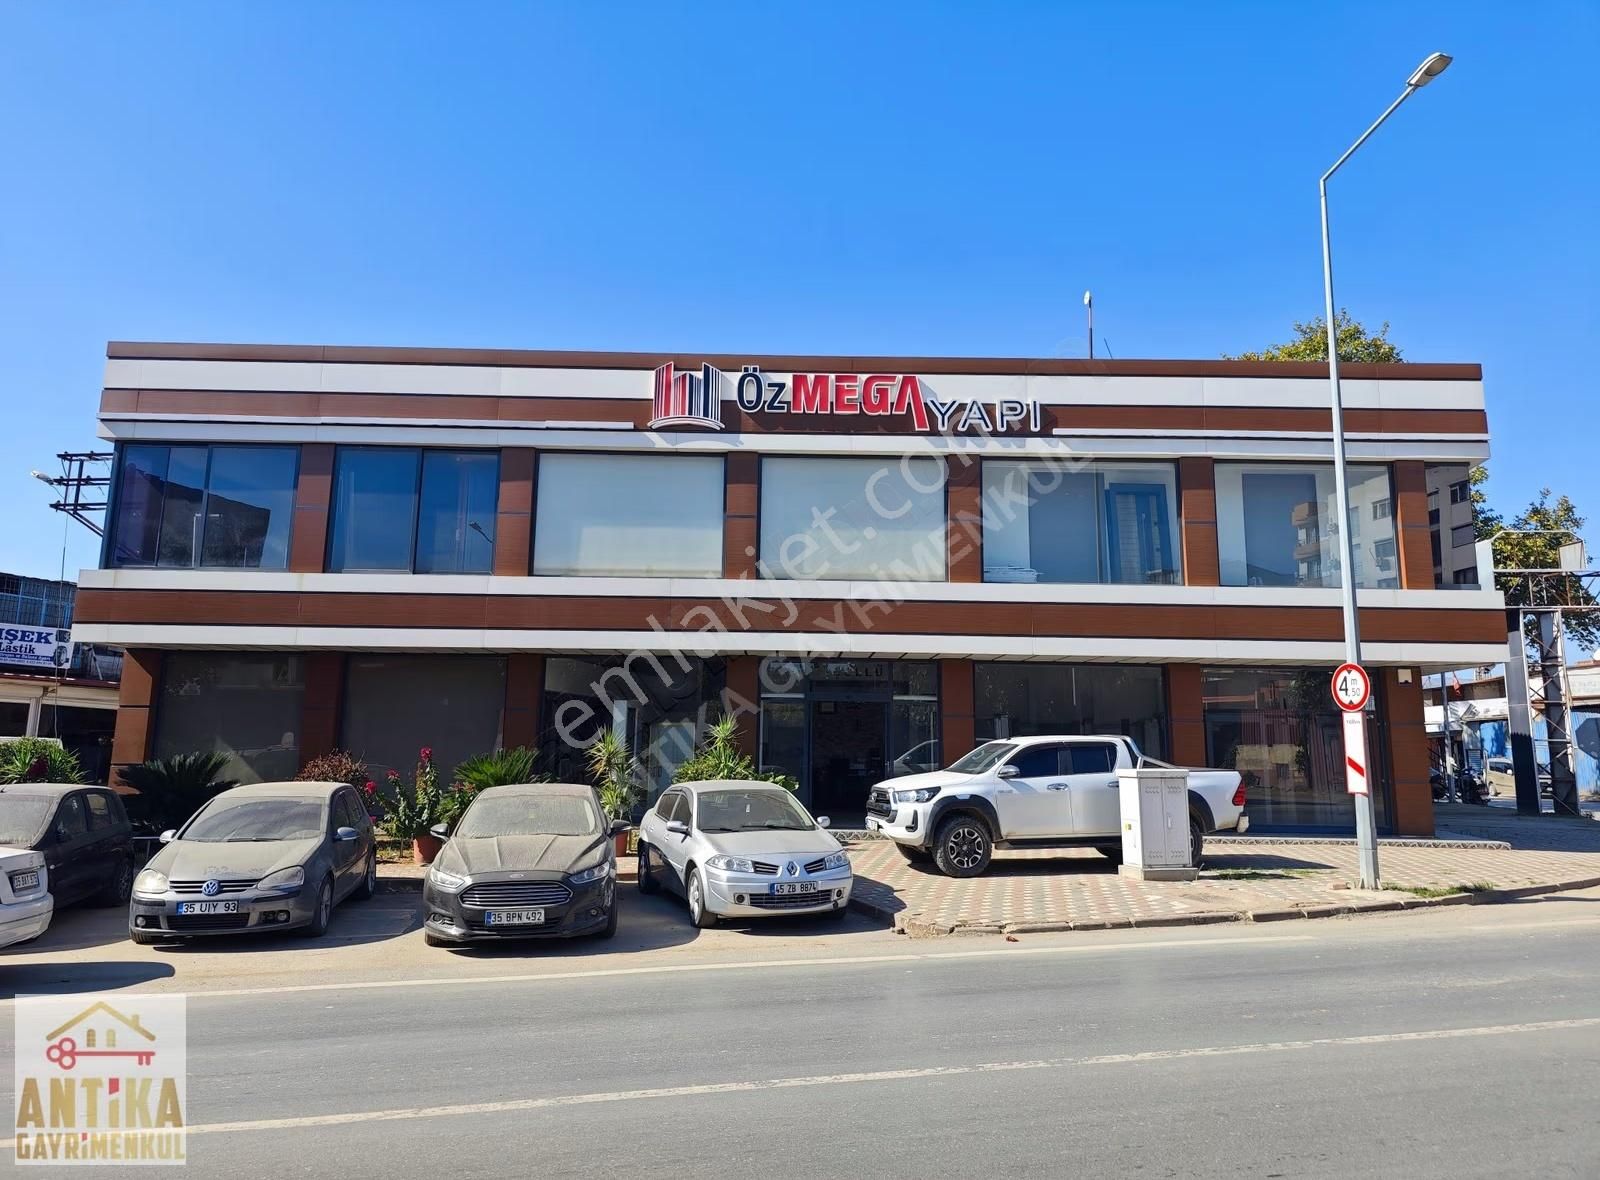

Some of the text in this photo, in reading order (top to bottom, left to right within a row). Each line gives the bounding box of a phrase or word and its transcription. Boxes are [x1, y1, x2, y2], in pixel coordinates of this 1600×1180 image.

[927, 398, 1041, 432] YAPI
[775, 884, 785, 893] 45
[787, 884, 796, 892] ZB
[183, 902, 236, 913] 35 UIY 93
[492, 911, 542, 922] 35 BPN 492
